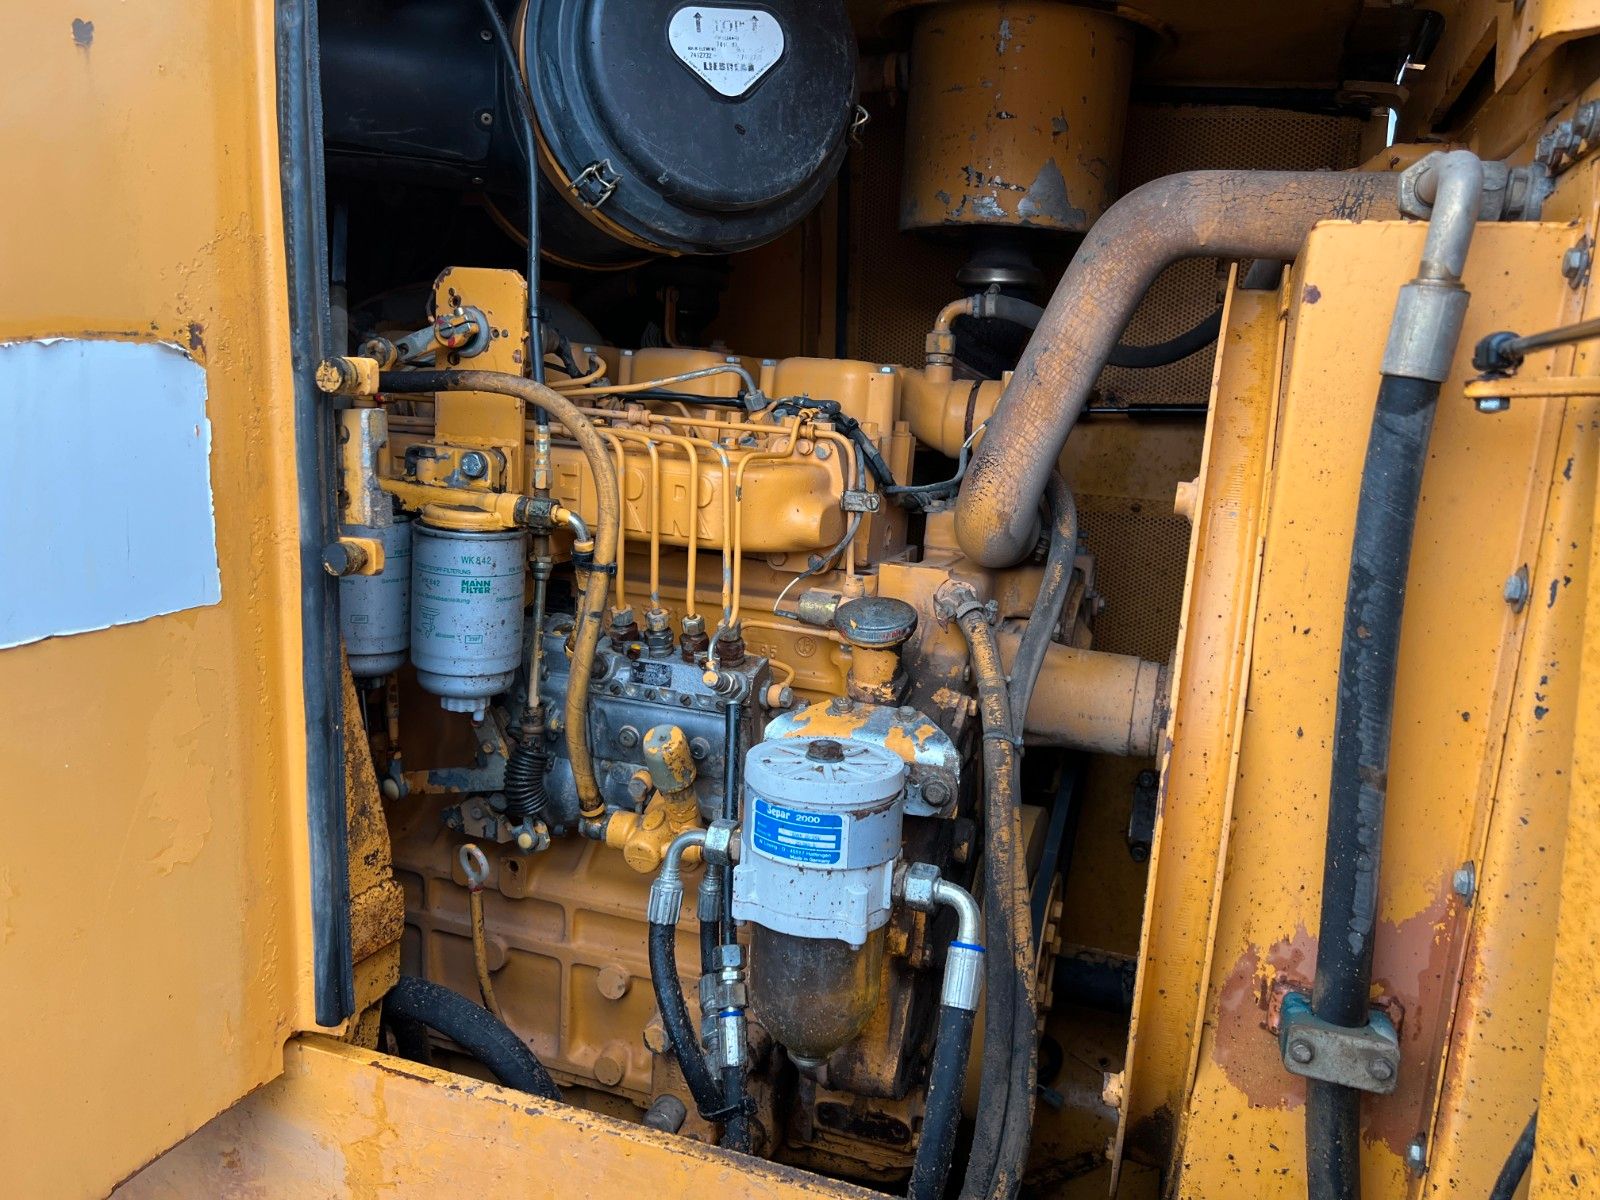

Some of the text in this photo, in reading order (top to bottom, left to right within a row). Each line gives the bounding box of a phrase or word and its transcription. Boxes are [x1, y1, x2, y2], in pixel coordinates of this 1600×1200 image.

[460, 555, 492, 565] WK 842
[766, 804, 821, 824] Separ 2000
